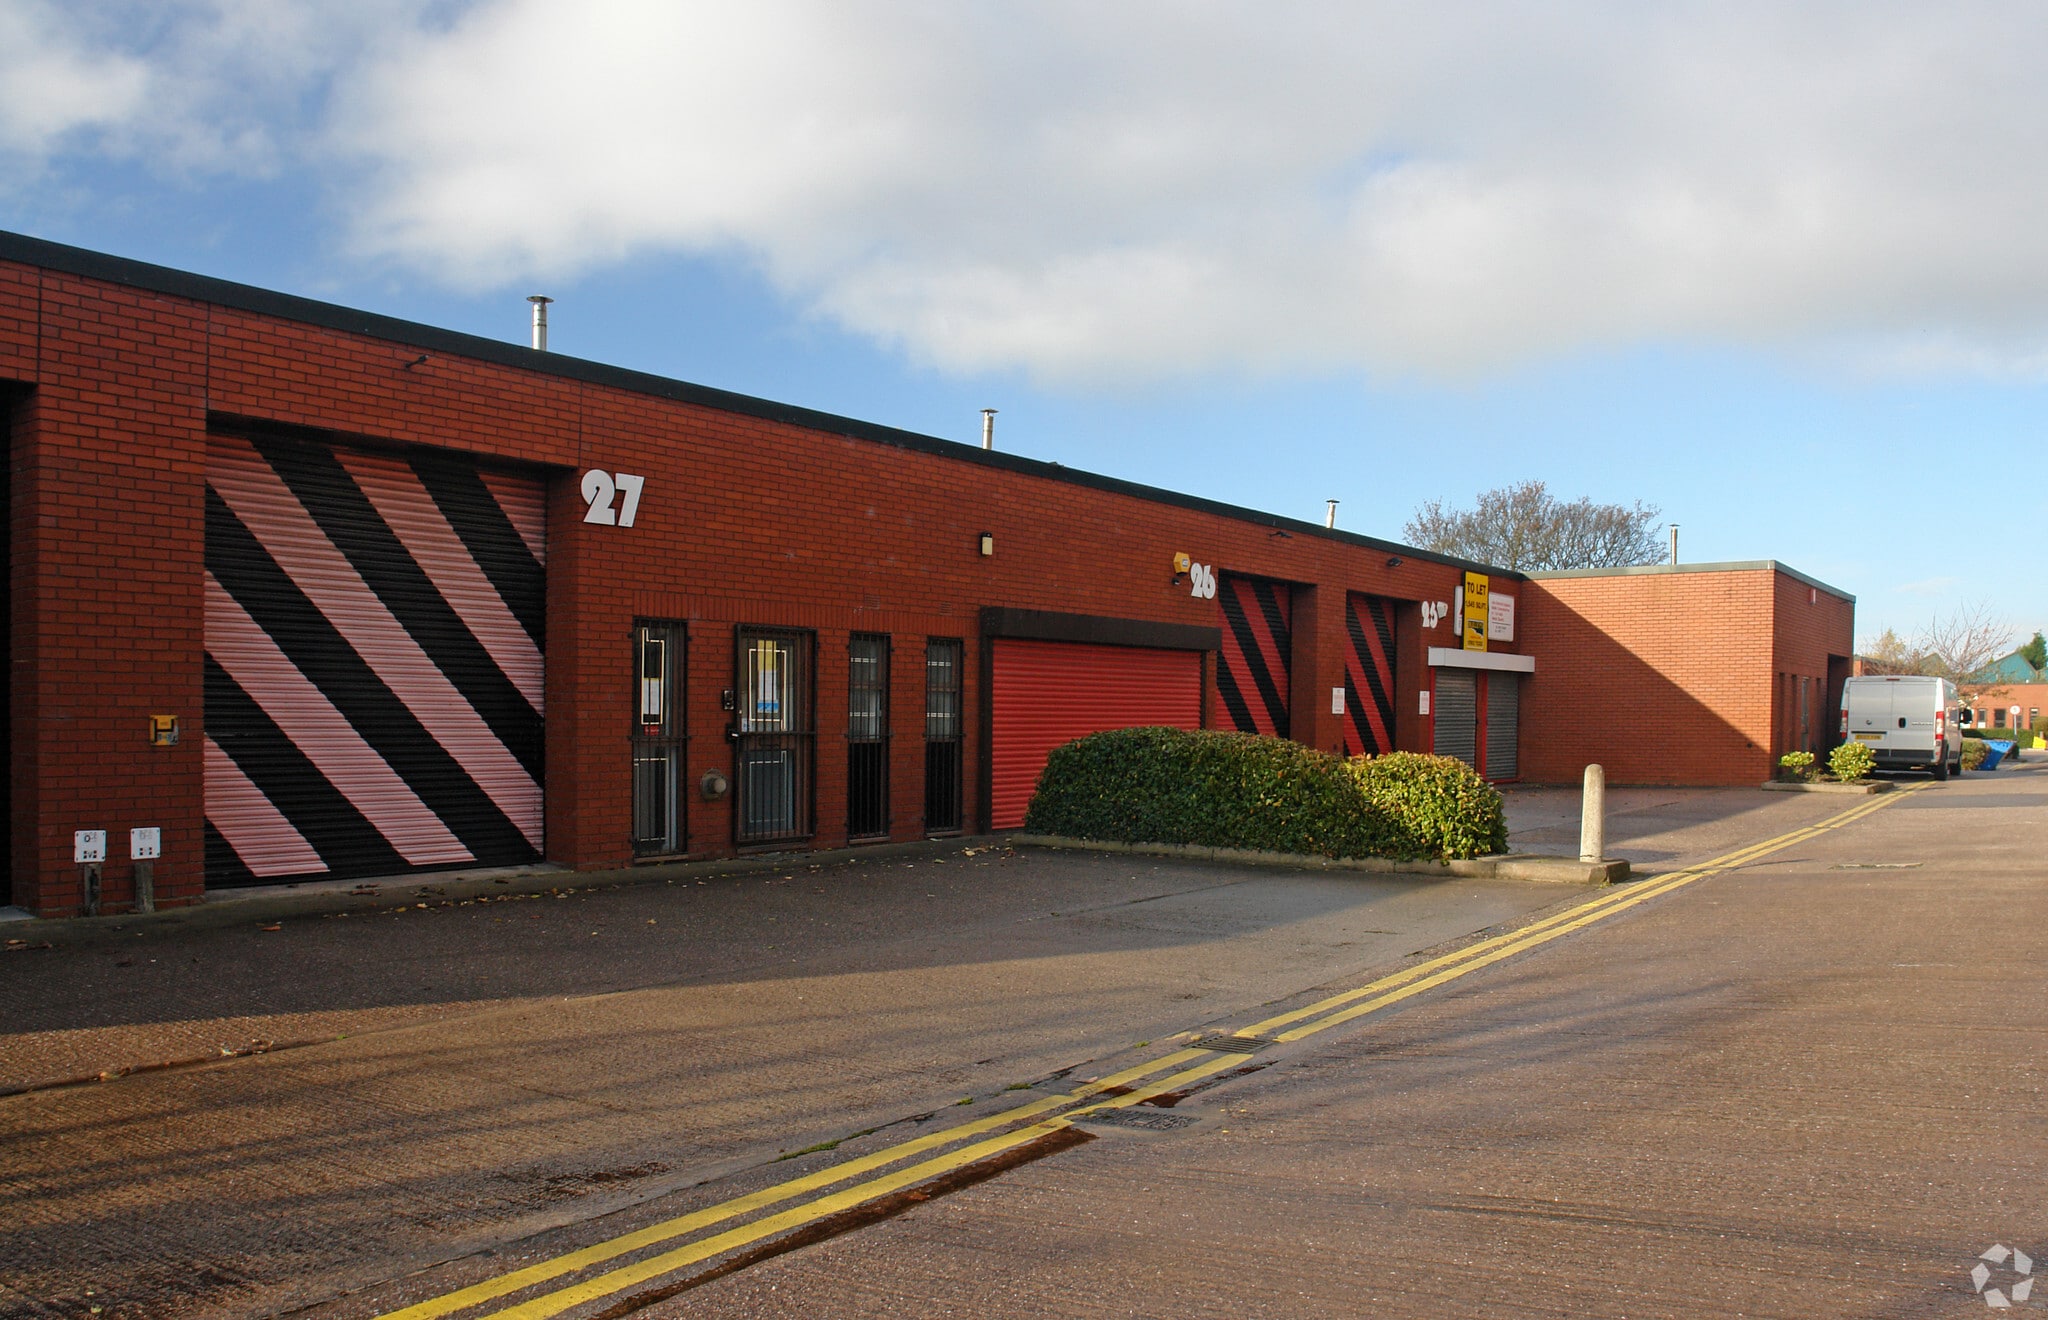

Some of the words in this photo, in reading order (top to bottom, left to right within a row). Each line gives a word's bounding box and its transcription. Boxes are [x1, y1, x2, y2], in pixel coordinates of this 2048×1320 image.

[581, 469, 645, 528] 27
[1190, 562, 1216, 600] 26
[1467, 581, 1475, 594] TO
[1476, 584, 1487, 596] LET
